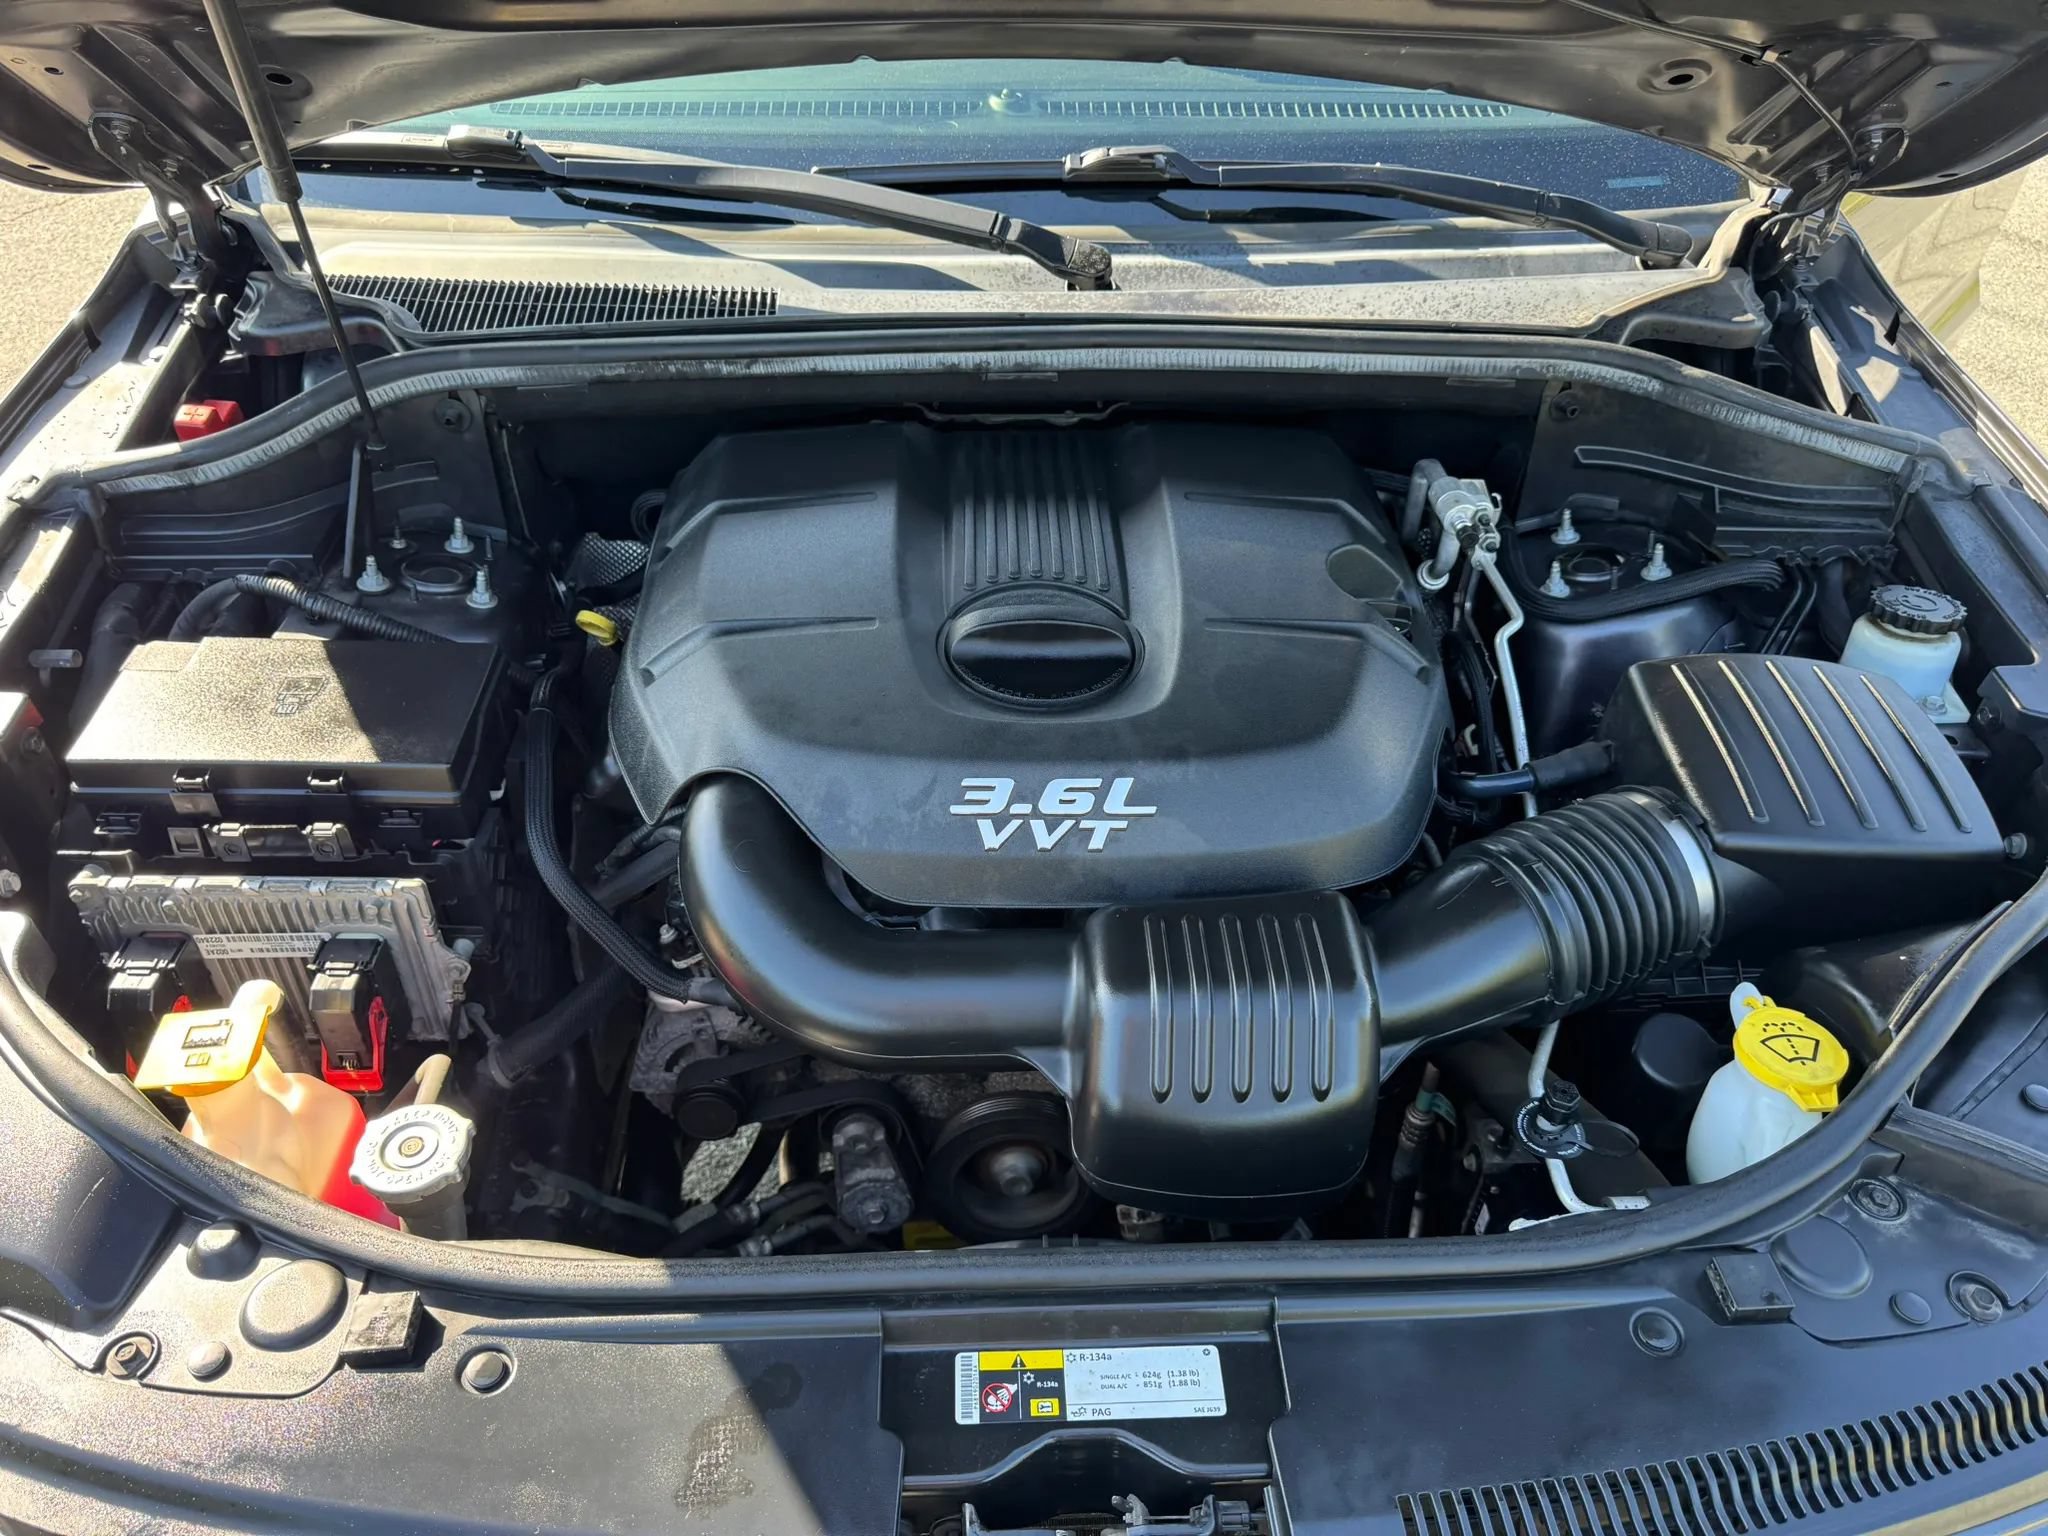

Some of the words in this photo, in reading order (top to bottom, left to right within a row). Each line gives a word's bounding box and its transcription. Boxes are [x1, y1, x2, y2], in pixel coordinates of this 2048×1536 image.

[949, 777, 1158, 816] 3.6L
[976, 819, 1129, 852] VVT
[1079, 1353, 1112, 1362] R-134a
[1142, 1371, 1162, 1380] 624g
[1167, 1369, 1187, 1379] (1.38
[1189, 1369, 1200, 1377] lb)
[1143, 1380, 1163, 1389] 851g
[1168, 1379, 1189, 1389] (1.88
[1190, 1378, 1201, 1387] lb)
[1091, 1407, 1112, 1416] PAG
